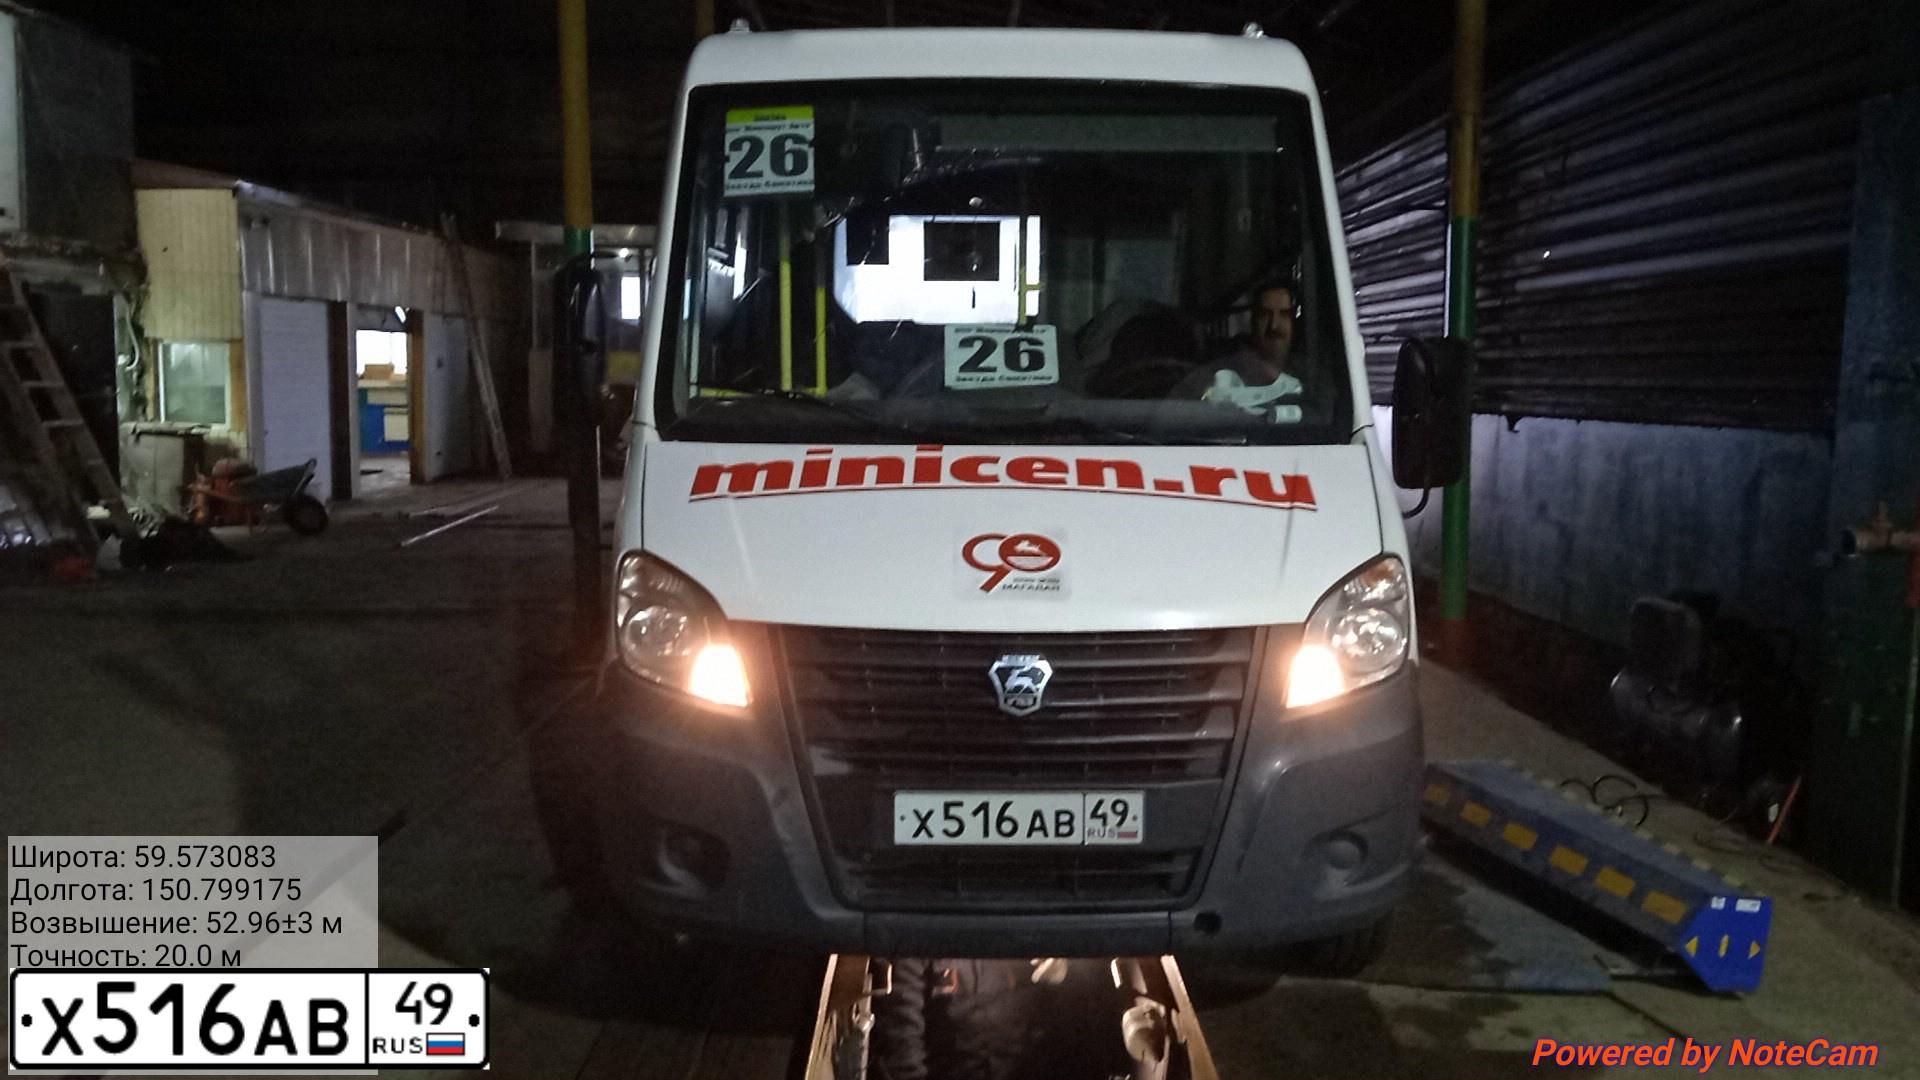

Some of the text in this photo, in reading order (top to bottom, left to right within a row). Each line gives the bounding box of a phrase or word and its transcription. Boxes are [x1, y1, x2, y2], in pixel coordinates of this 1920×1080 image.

[727, 133, 809, 180] 26
[958, 335, 1046, 373] 26
[692, 444, 1317, 502] minicen.ru
[1089, 798, 1131, 828] 49
[1086, 828, 1117, 839] RUS
